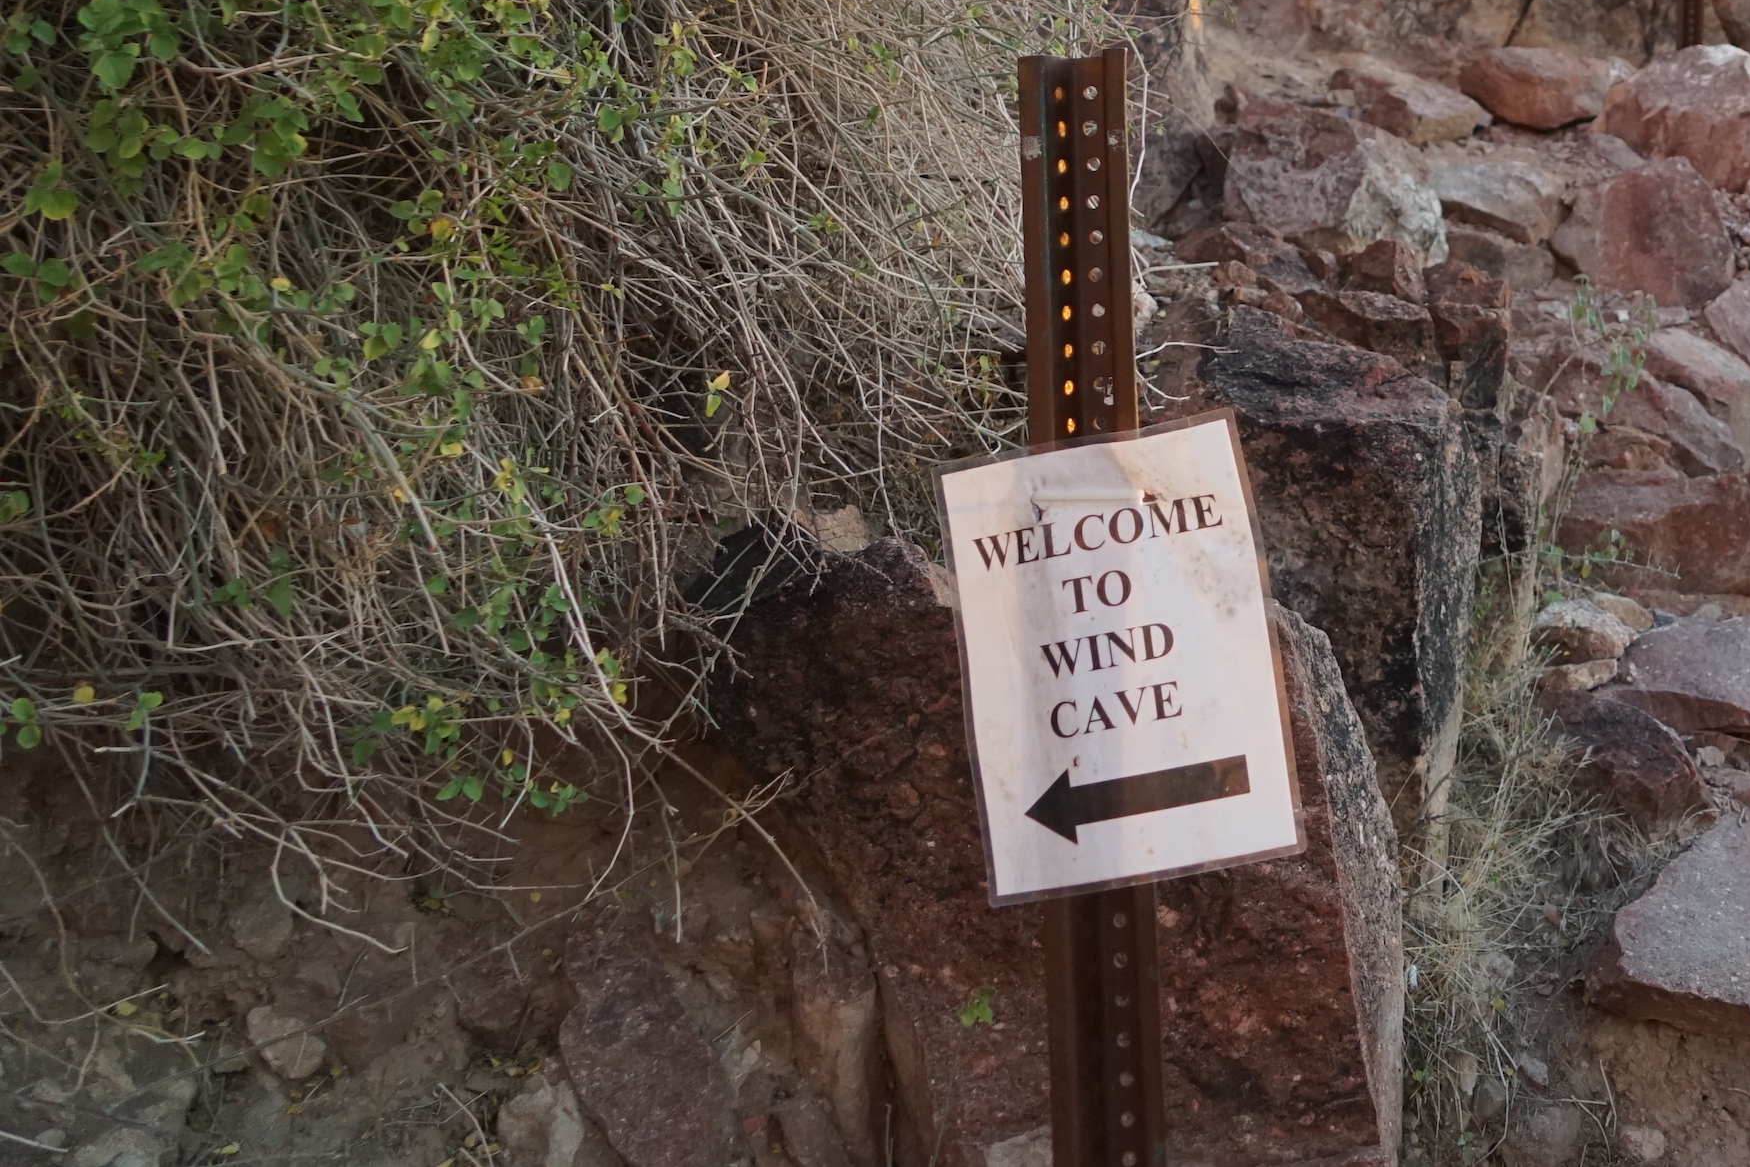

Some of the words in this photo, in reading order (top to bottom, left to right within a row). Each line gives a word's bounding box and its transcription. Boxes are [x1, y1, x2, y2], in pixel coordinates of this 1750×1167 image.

[972, 494, 1223, 572] WELCOME
[1062, 570, 1132, 615] TO
[1040, 623, 1175, 679] WIND
[1050, 681, 1183, 739] CAVE
